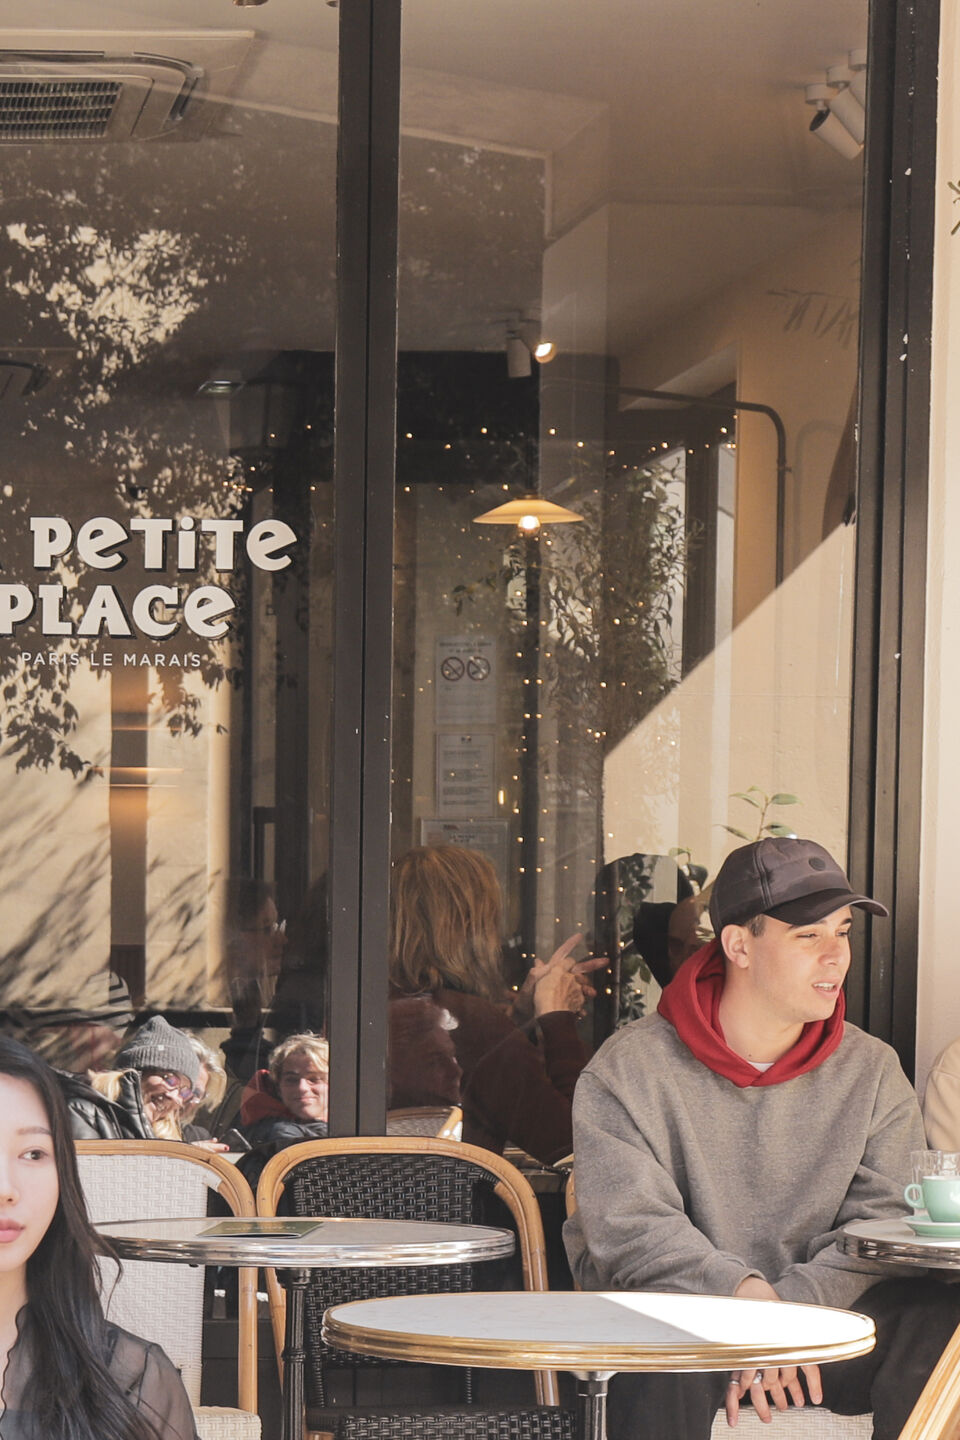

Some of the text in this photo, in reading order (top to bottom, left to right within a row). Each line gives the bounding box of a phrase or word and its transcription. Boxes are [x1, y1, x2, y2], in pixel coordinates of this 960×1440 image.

[21, 652, 202, 667] PARIS LE MARAIS
